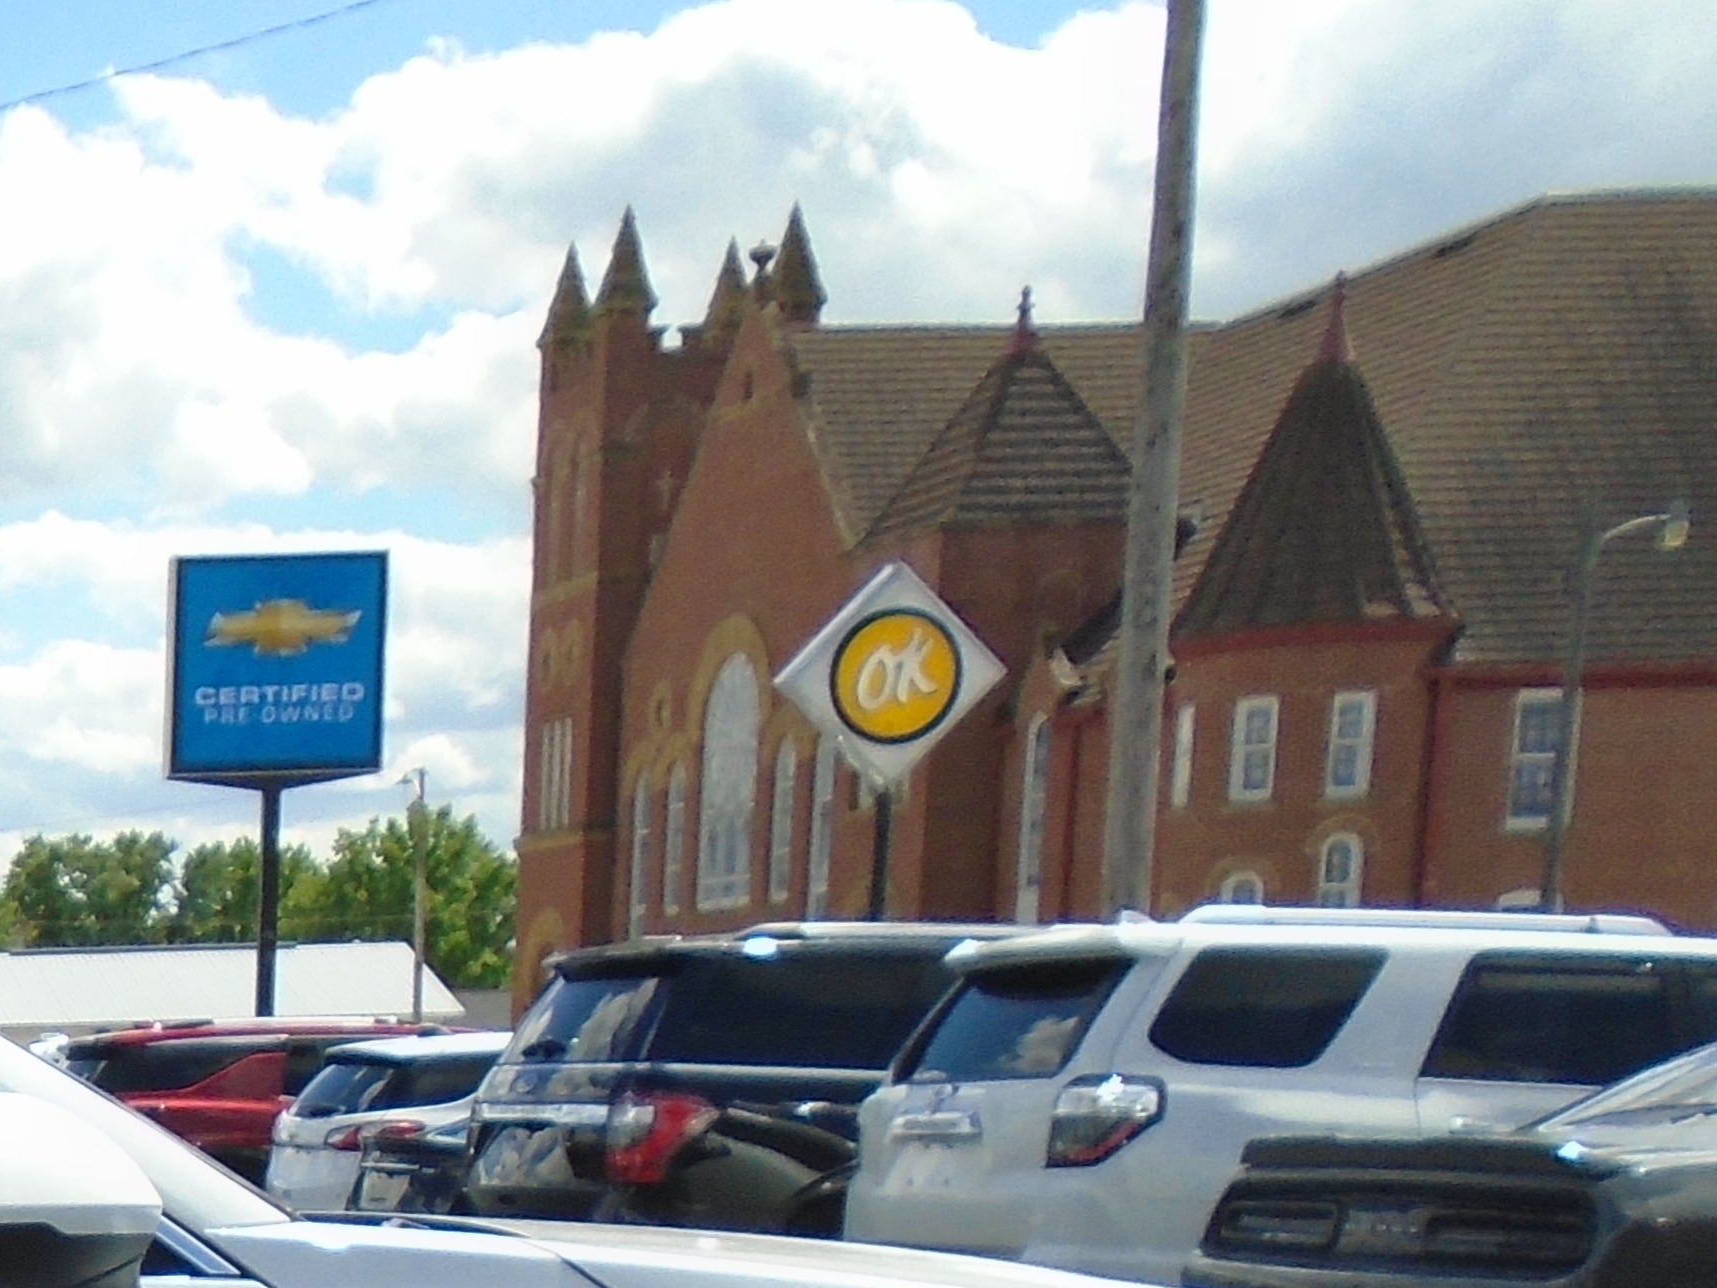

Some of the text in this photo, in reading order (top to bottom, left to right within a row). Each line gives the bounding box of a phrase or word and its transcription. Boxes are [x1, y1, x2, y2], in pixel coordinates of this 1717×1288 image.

[856, 627, 939, 710] OK
[194, 682, 366, 706] CERTIFIED
[261, 701, 356, 724] OWNED
